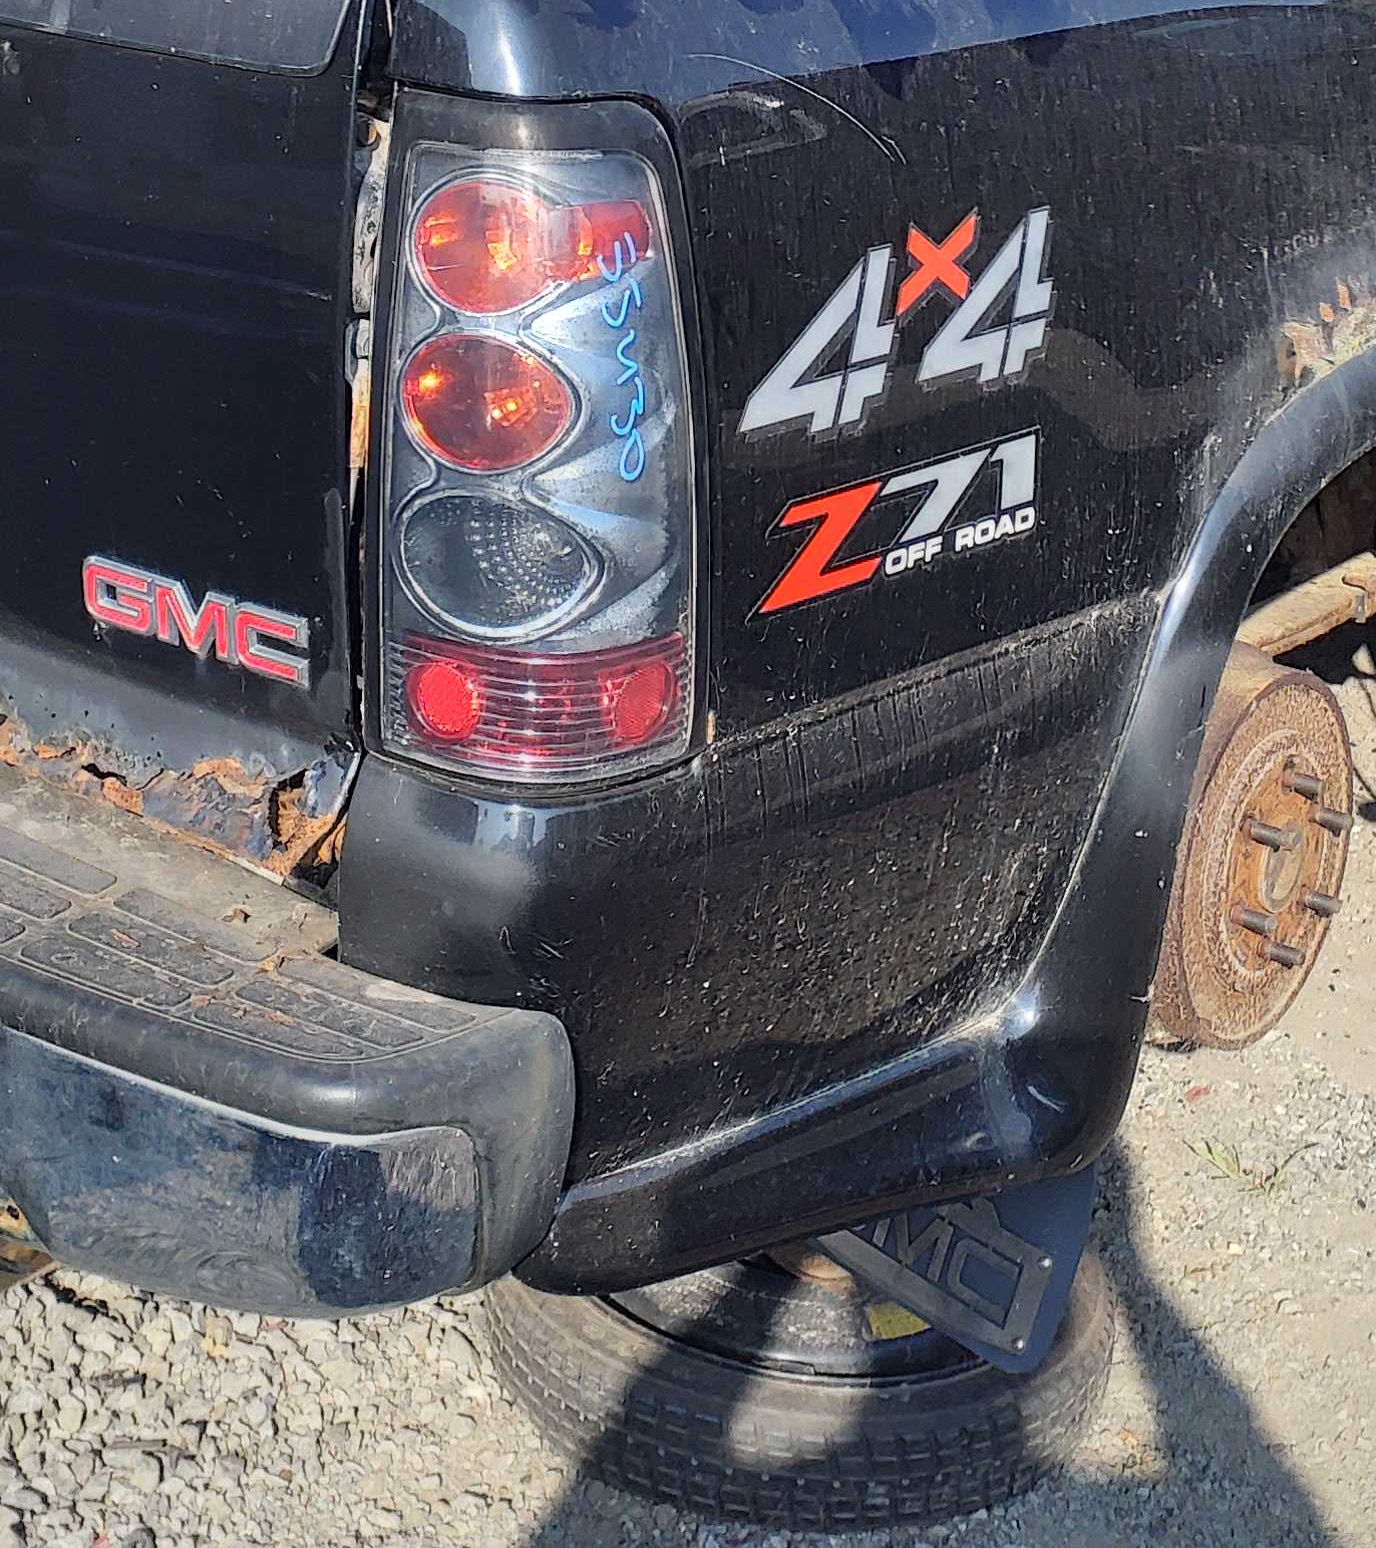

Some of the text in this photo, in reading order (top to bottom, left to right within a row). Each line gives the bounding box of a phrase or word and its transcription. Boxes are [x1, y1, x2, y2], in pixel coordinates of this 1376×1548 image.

[752, 429, 1039, 619] Z71
[883, 505, 1037, 577] OFF ROAD
[82, 554, 311, 692] GMC
